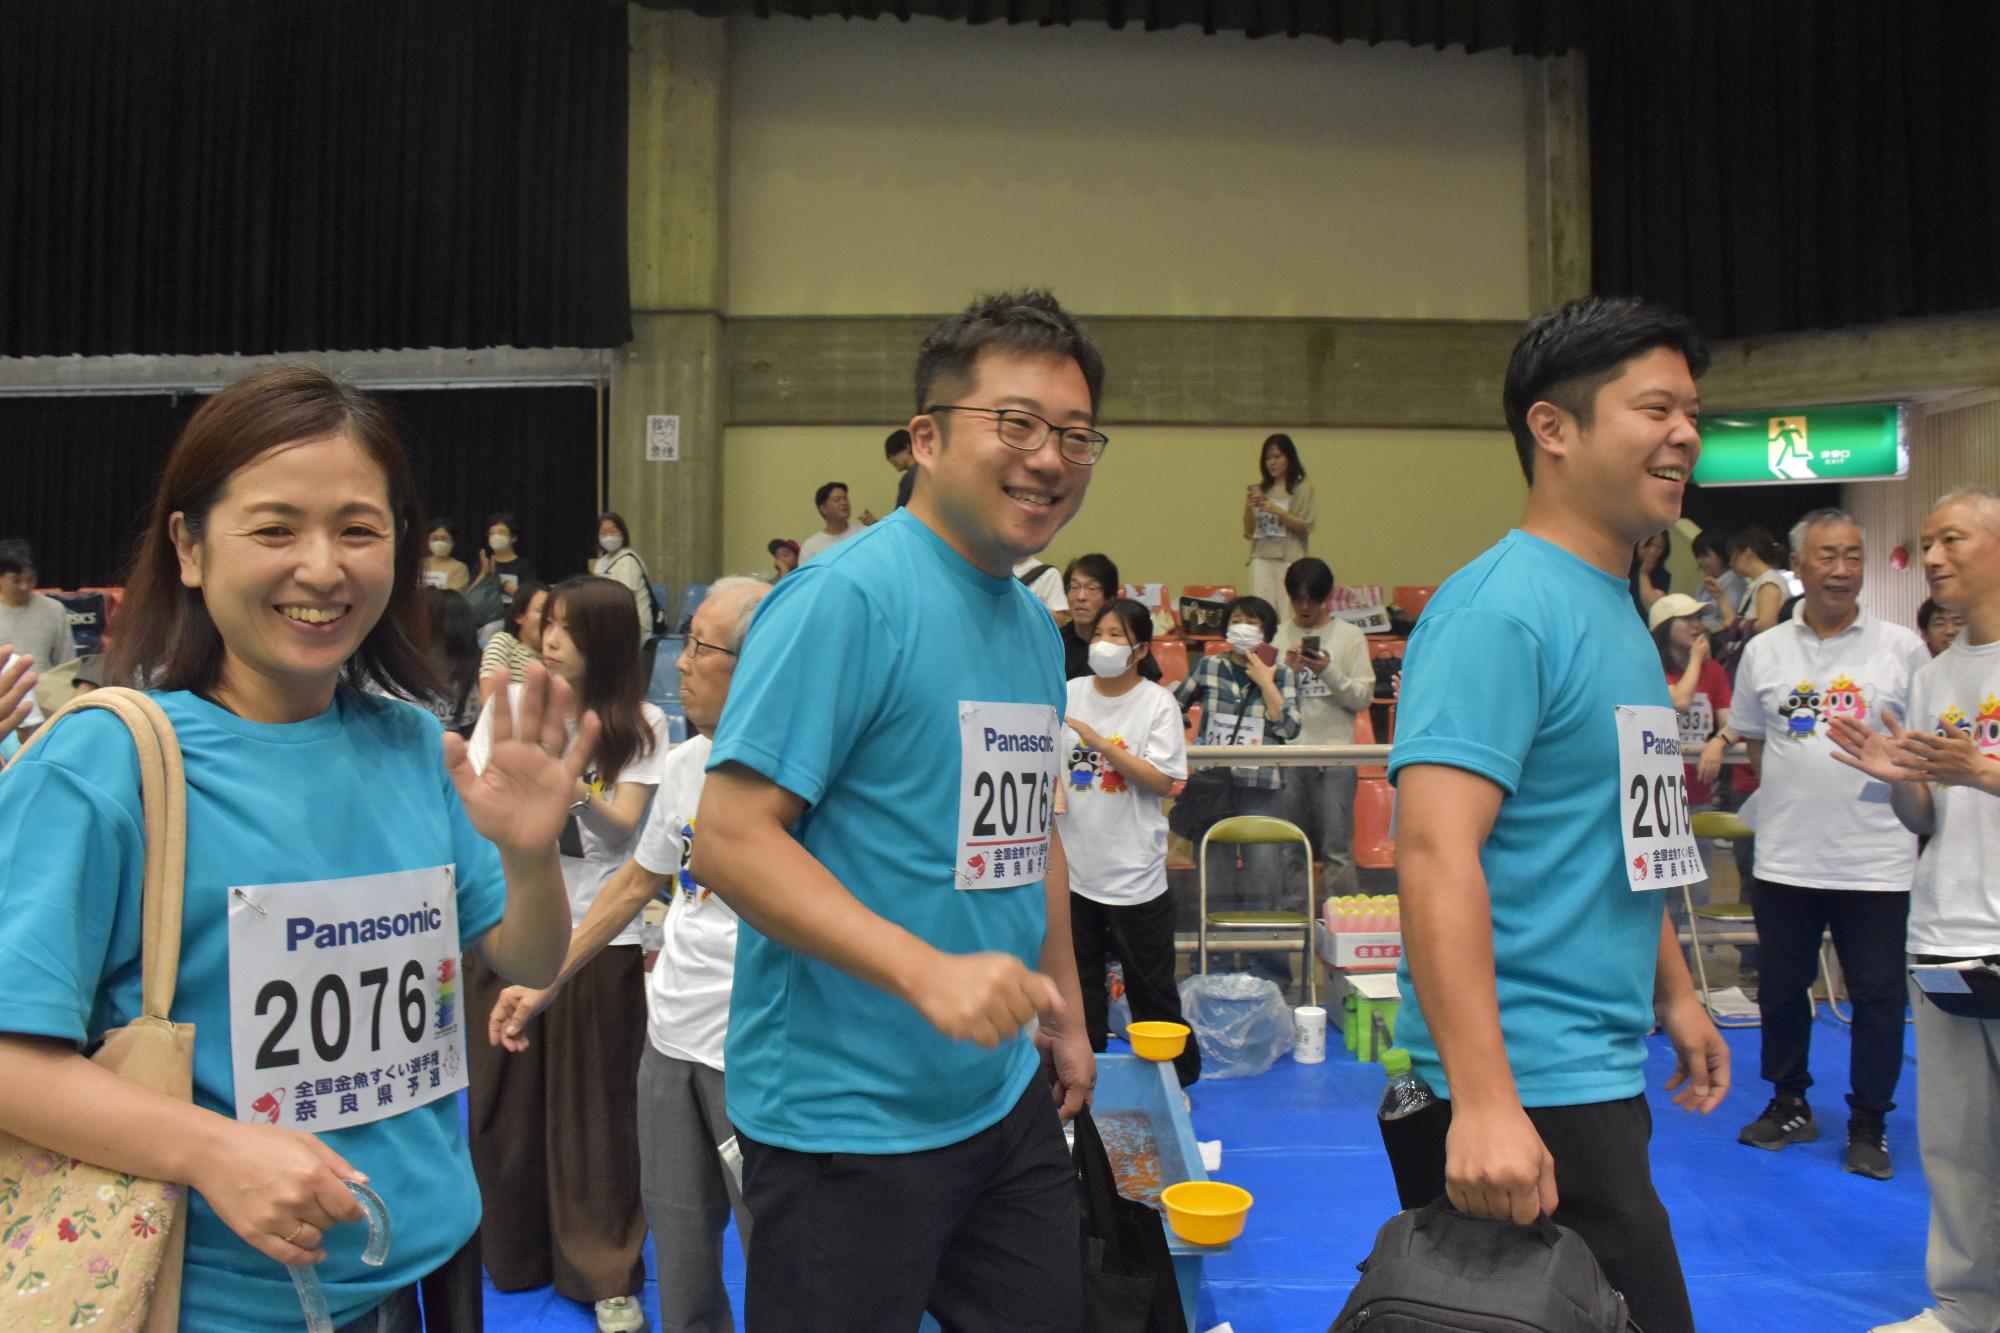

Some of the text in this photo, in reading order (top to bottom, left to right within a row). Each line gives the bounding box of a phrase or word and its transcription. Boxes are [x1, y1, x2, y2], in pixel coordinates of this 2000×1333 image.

[972, 770, 1049, 837] 2076
[286, 902, 441, 951] Panasonic
[254, 959, 427, 1070] 2076
[294, 1050, 440, 1098] 全国金魚すくい選手権
